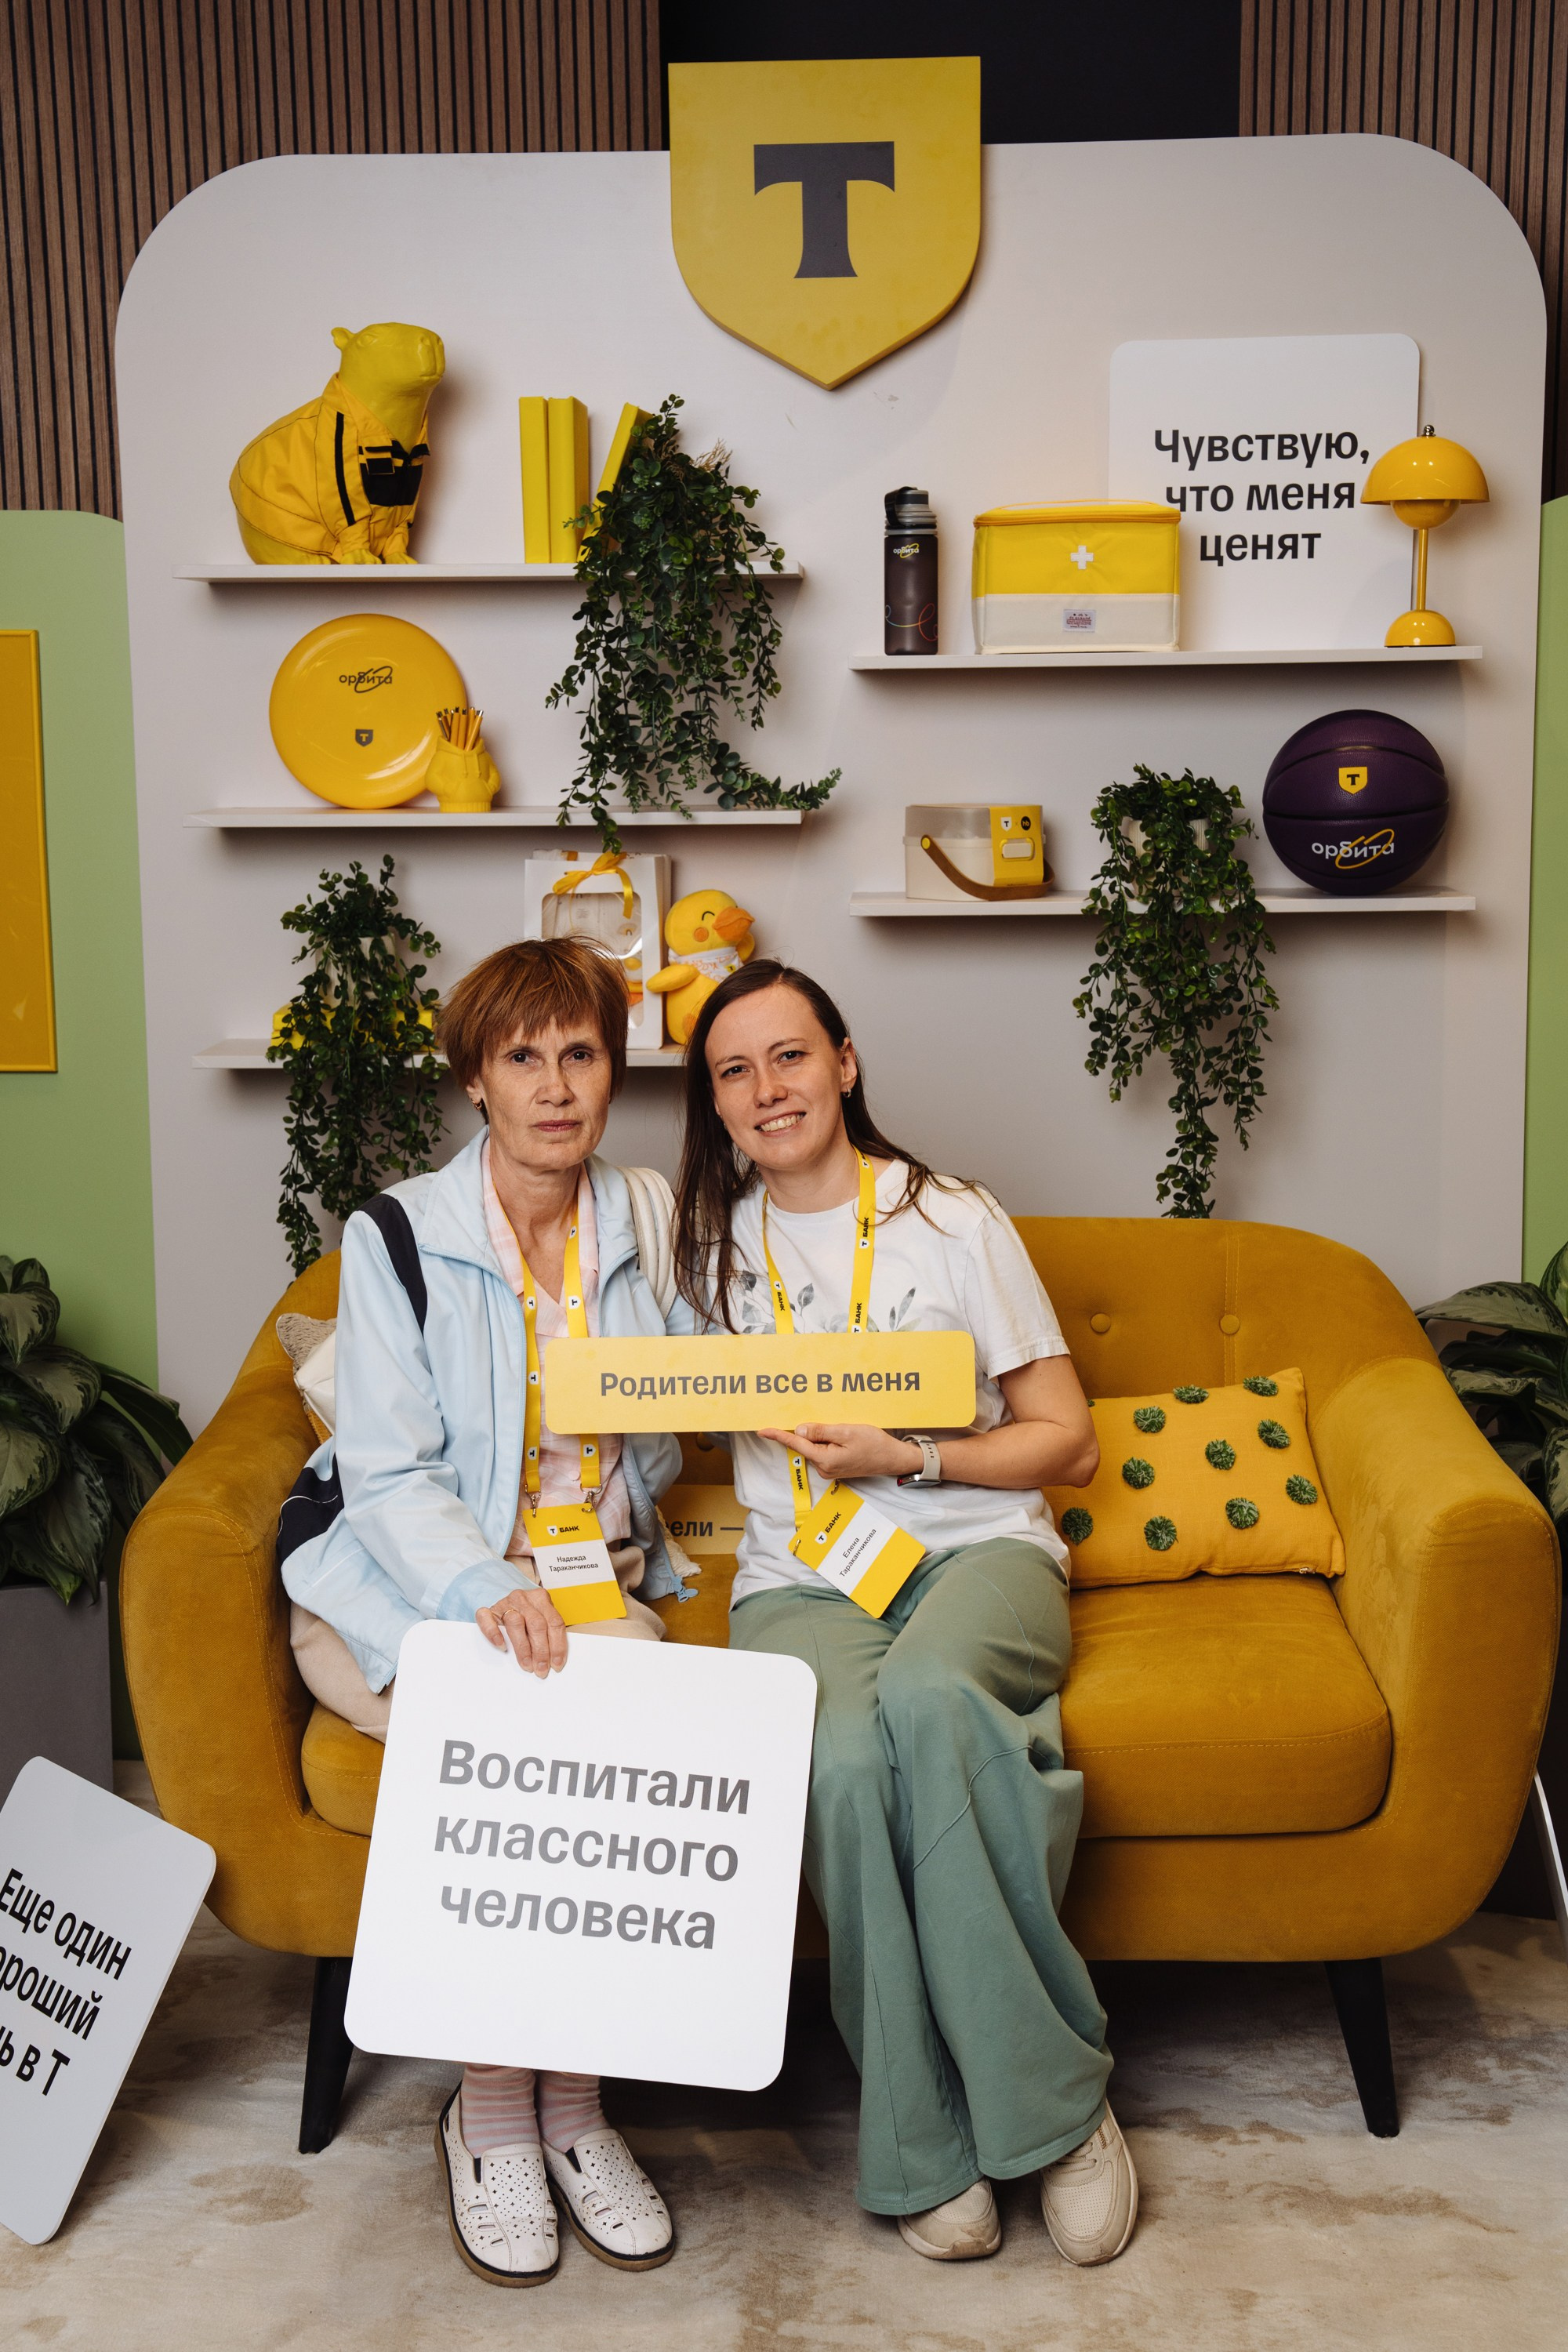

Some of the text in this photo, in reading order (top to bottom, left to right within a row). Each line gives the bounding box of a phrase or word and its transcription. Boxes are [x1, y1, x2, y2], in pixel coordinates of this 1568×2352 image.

[753, 141, 895, 278] Т
[1154, 430, 1370, 471] Чувствую,
[1166, 482, 1355, 512] что меня
[1200, 533, 1322, 567] ценят
[339, 671, 393, 687] орбита
[1346, 773, 1360, 786] Т
[1311, 840, 1396, 860] орбита
[777, 1291, 786, 1312] БАНК
[601, 1372, 921, 1400] Родители все в меня
[665, 1521, 713, 1537] ели
[825, 1512, 842, 1534] БАНК
[838, 1528, 877, 1578] Тараканчикова
[842, 1537, 860, 1559] Елена
[548, 1563, 599, 1573] Тараканчикова
[438, 1739, 751, 1815] Воспитали
[434, 1816, 739, 1882] классного
[0, 1867, 132, 1980] Еще один
[440, 1886, 717, 1951] человека
[16, 2043, 41, 2082] в
[42, 2049, 71, 2096] Т
